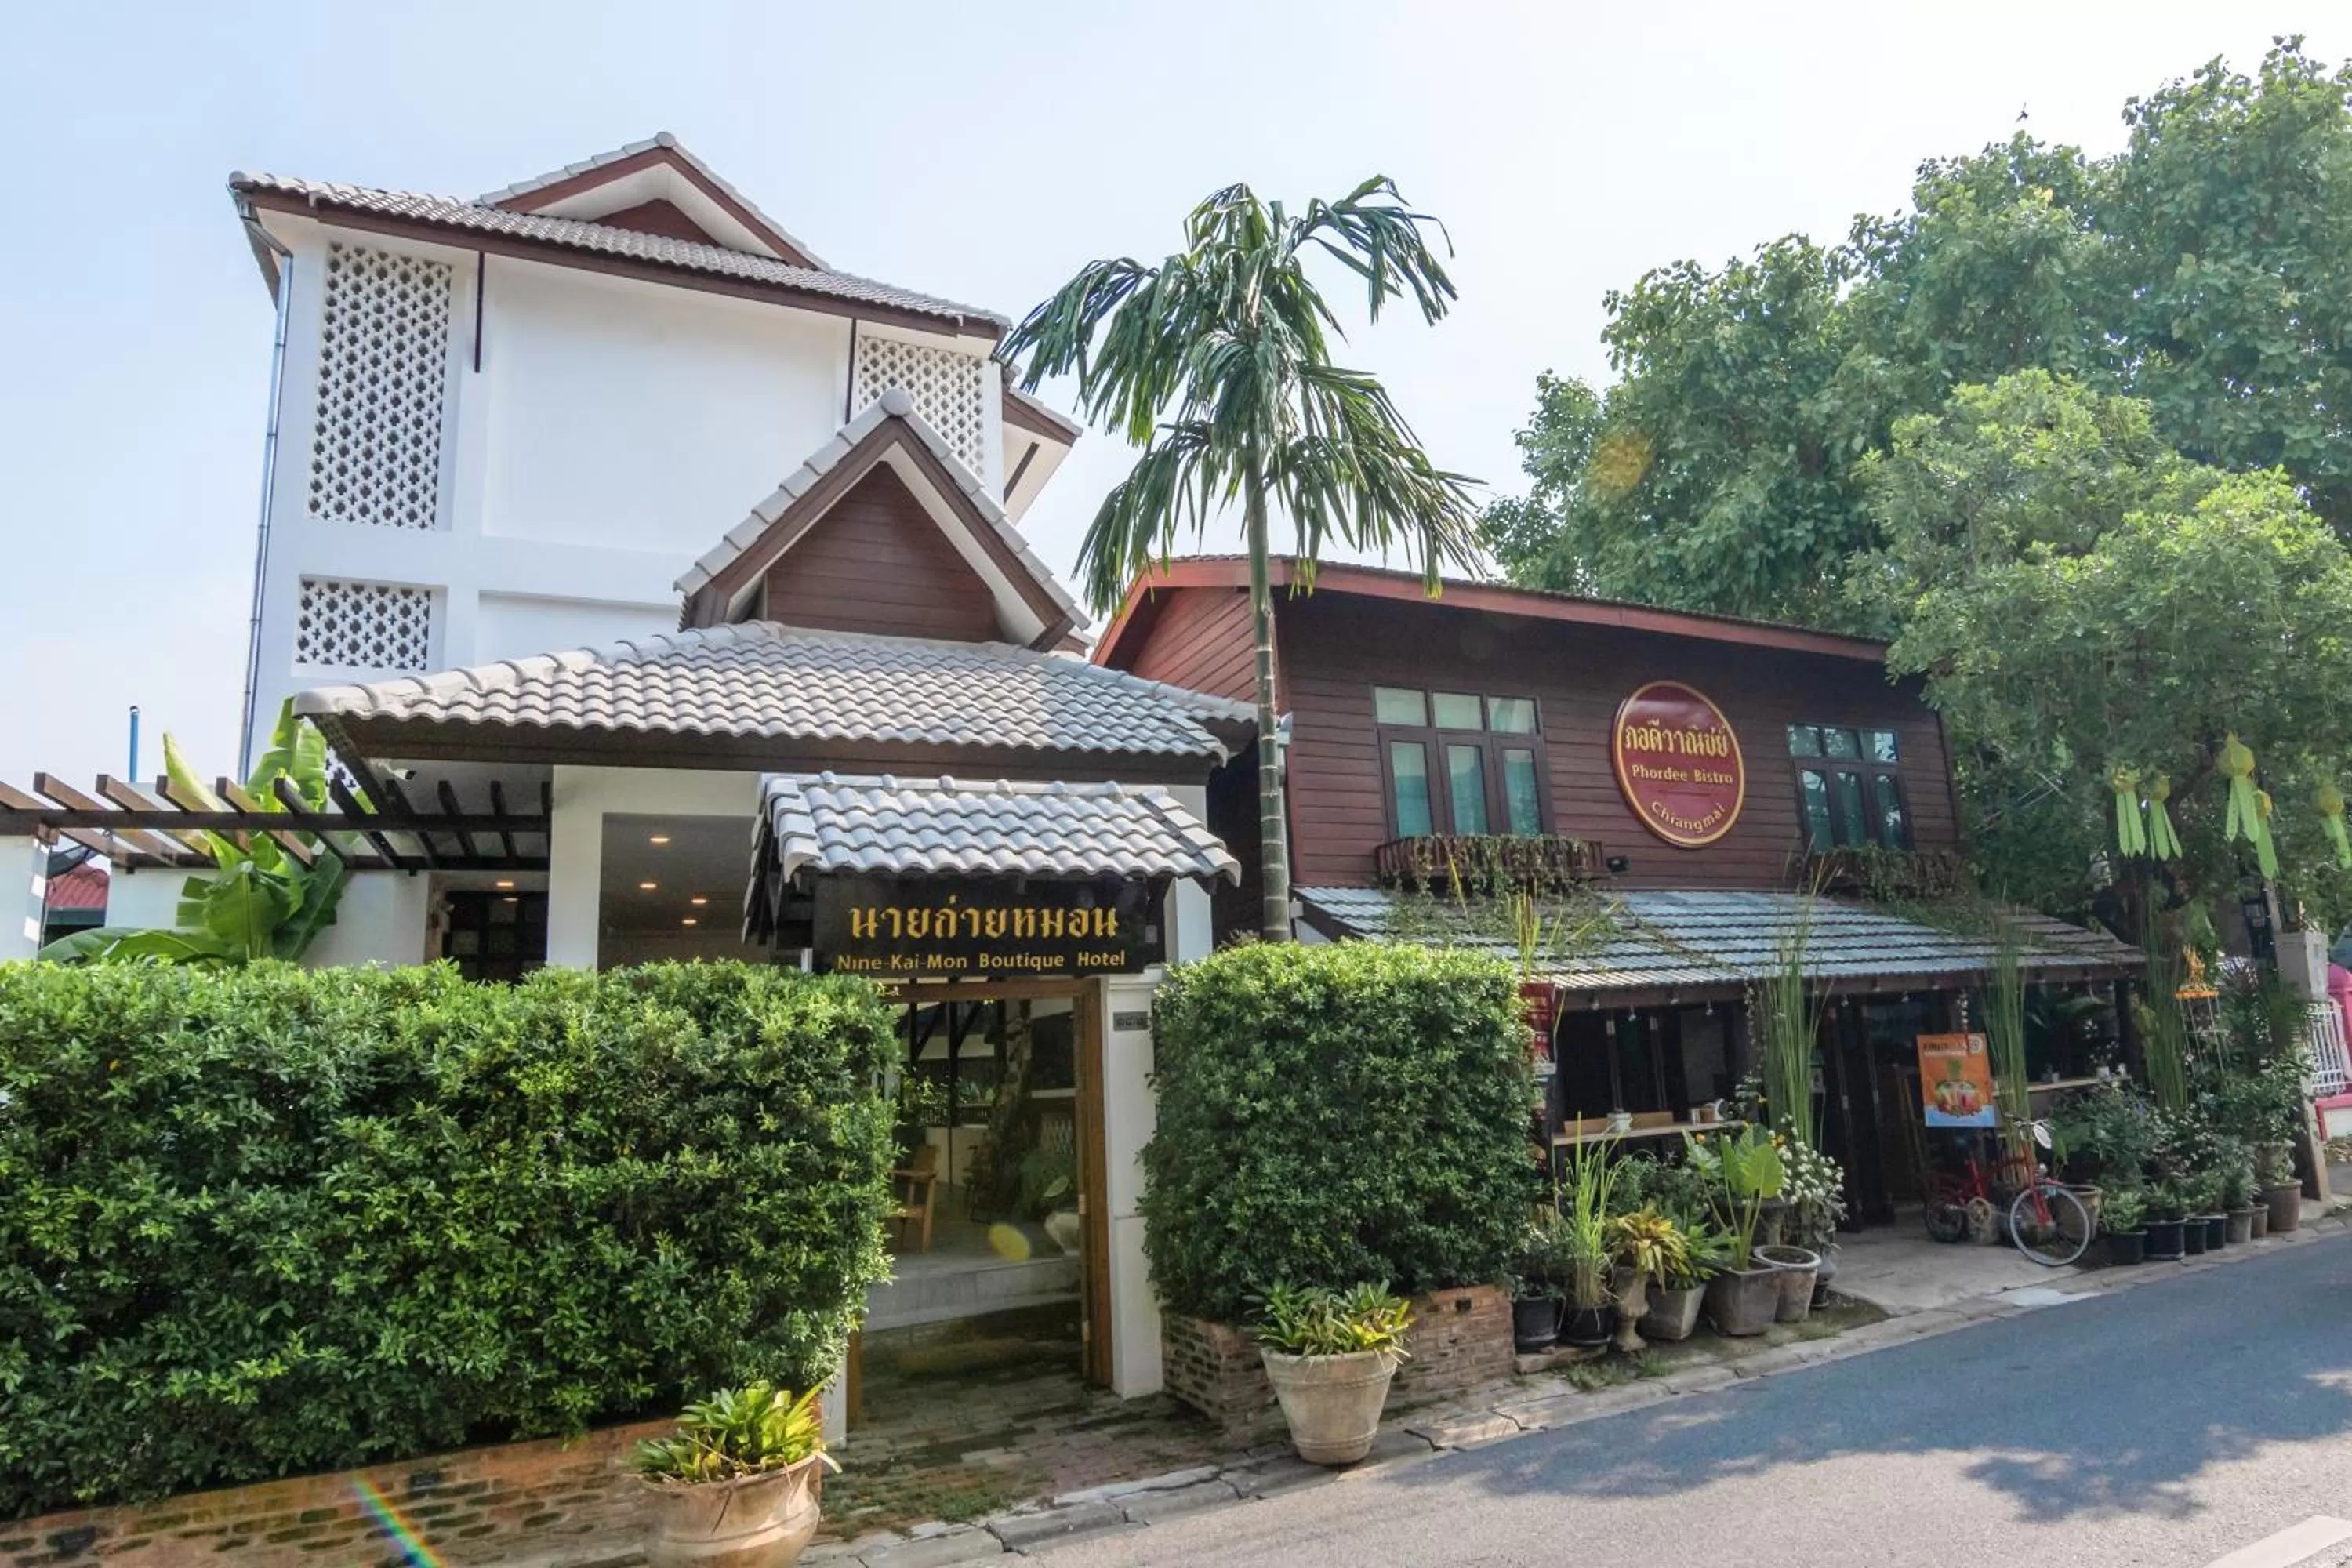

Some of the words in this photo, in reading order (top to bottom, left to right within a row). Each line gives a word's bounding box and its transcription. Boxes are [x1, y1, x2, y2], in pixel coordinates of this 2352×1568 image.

[1632, 764, 1688, 782] Phordee
[1693, 768, 1734, 784] Bistro
[1651, 800, 1726, 833] Chiangmai
[979, 952, 1065, 971] Boutique
[1077, 949, 1126, 967] Hotel
